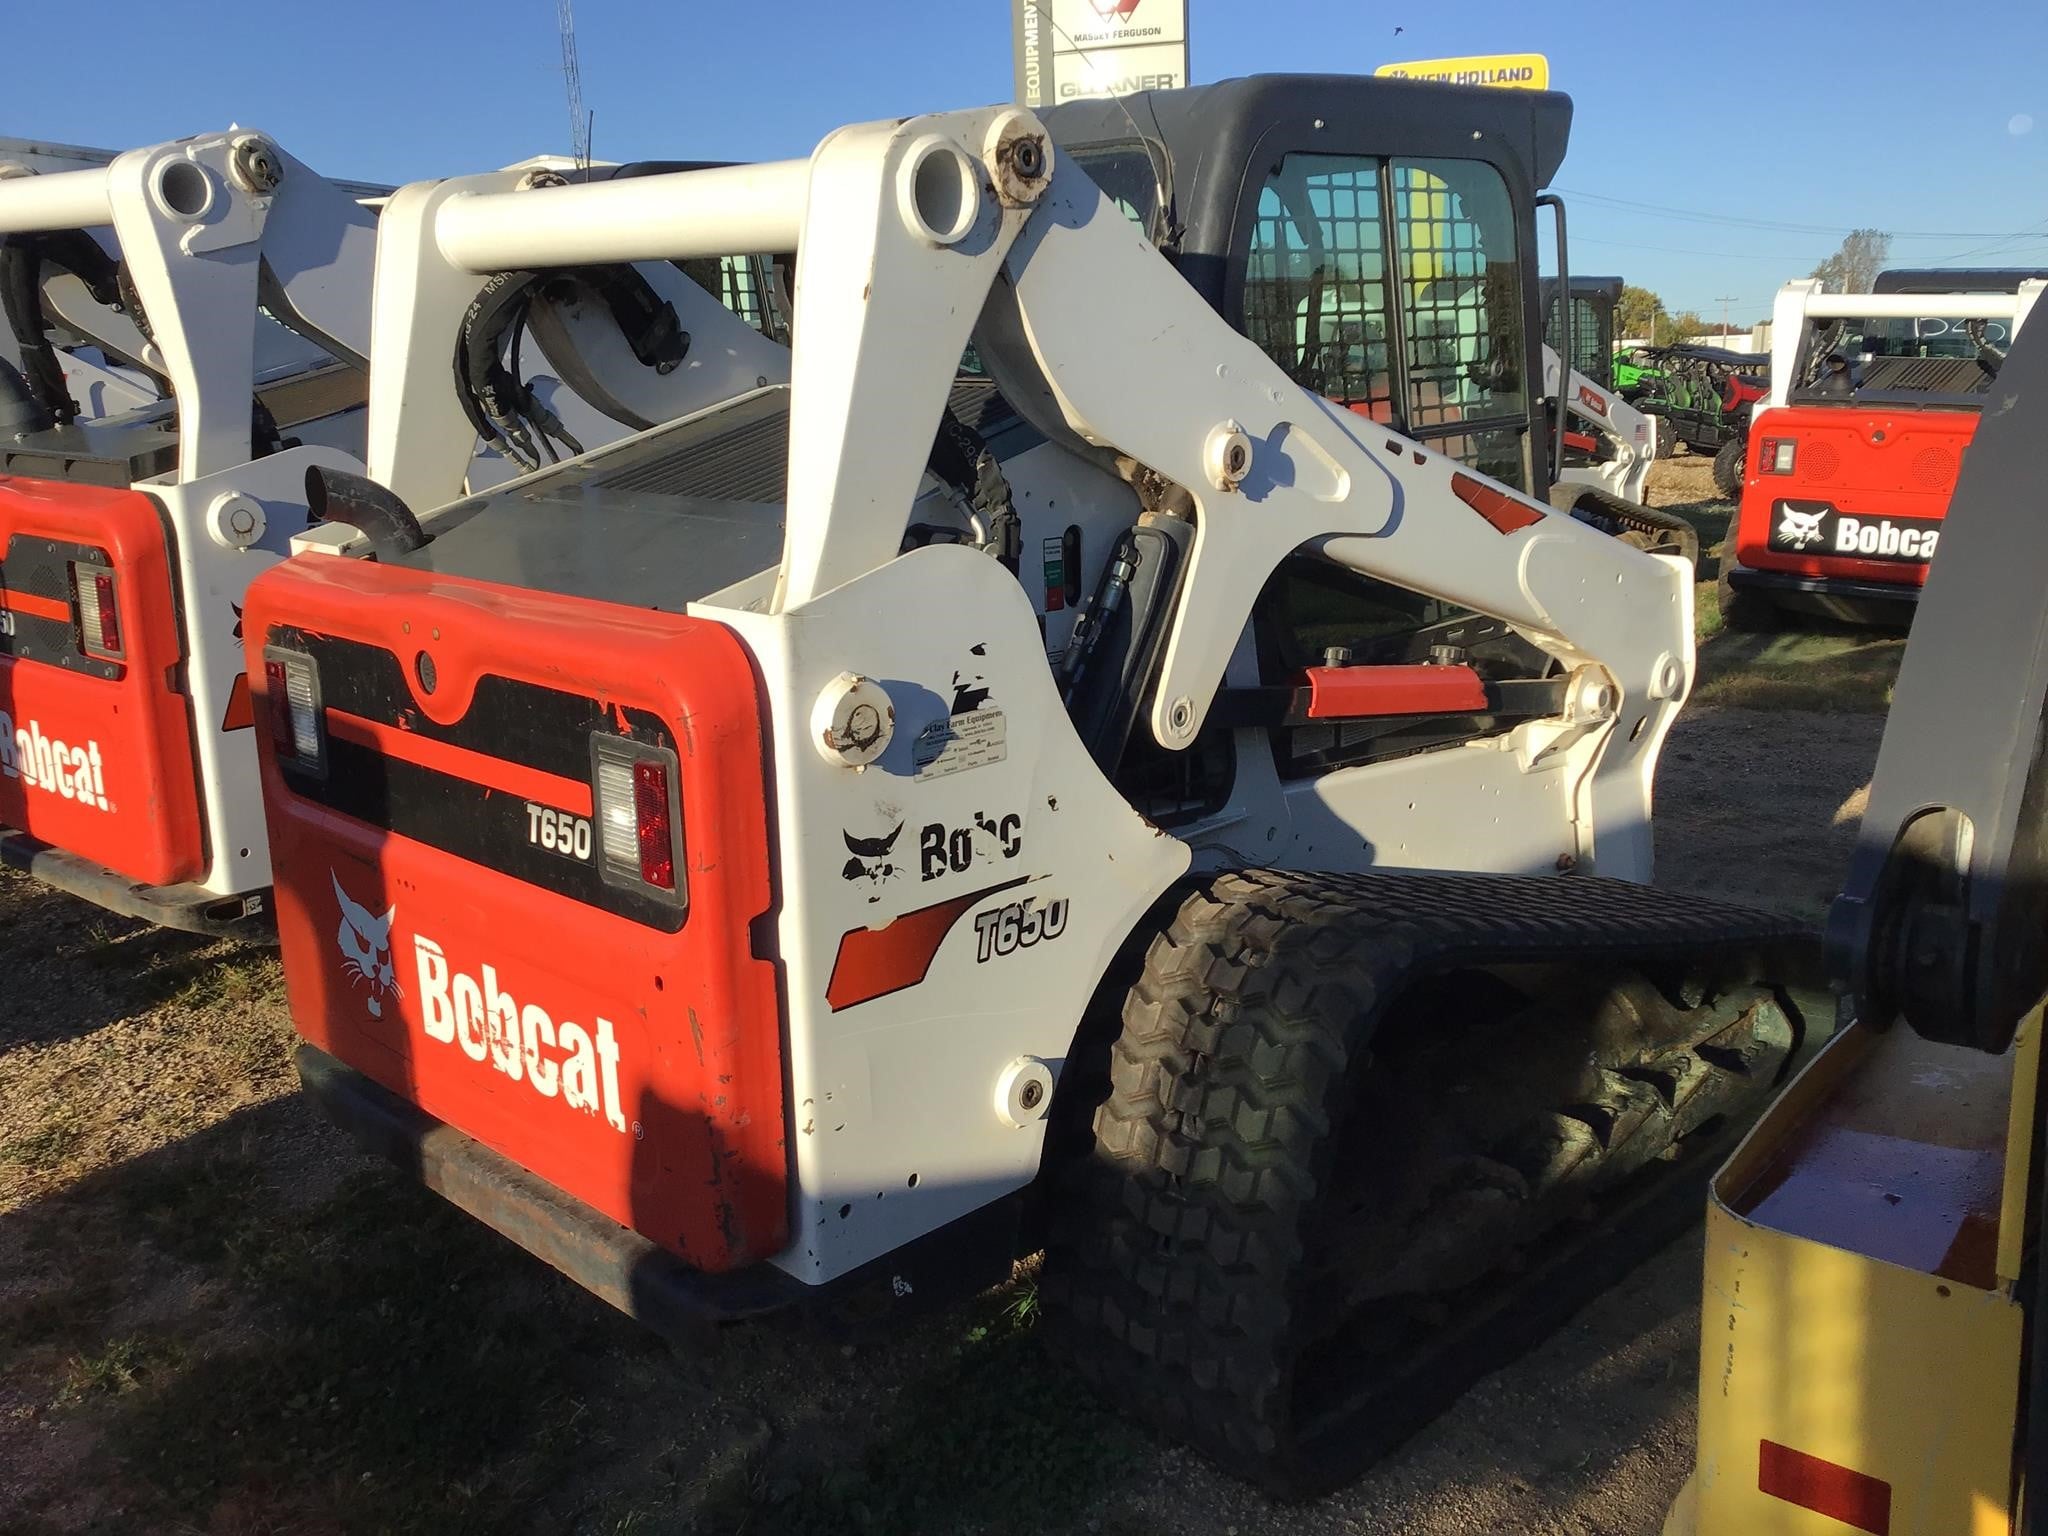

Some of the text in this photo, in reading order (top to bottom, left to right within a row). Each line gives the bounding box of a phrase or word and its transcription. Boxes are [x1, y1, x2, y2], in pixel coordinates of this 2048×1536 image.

[1113, 27, 1161, 39] FERGUSON
[1060, 73, 1173, 97] GLANER
[1457, 66, 1533, 84] HOLLAND
[1836, 517, 1940, 558] Bobca
[526, 803, 592, 861] T650
[975, 896, 1070, 964] T650
[413, 933, 627, 1133] Bobcat
